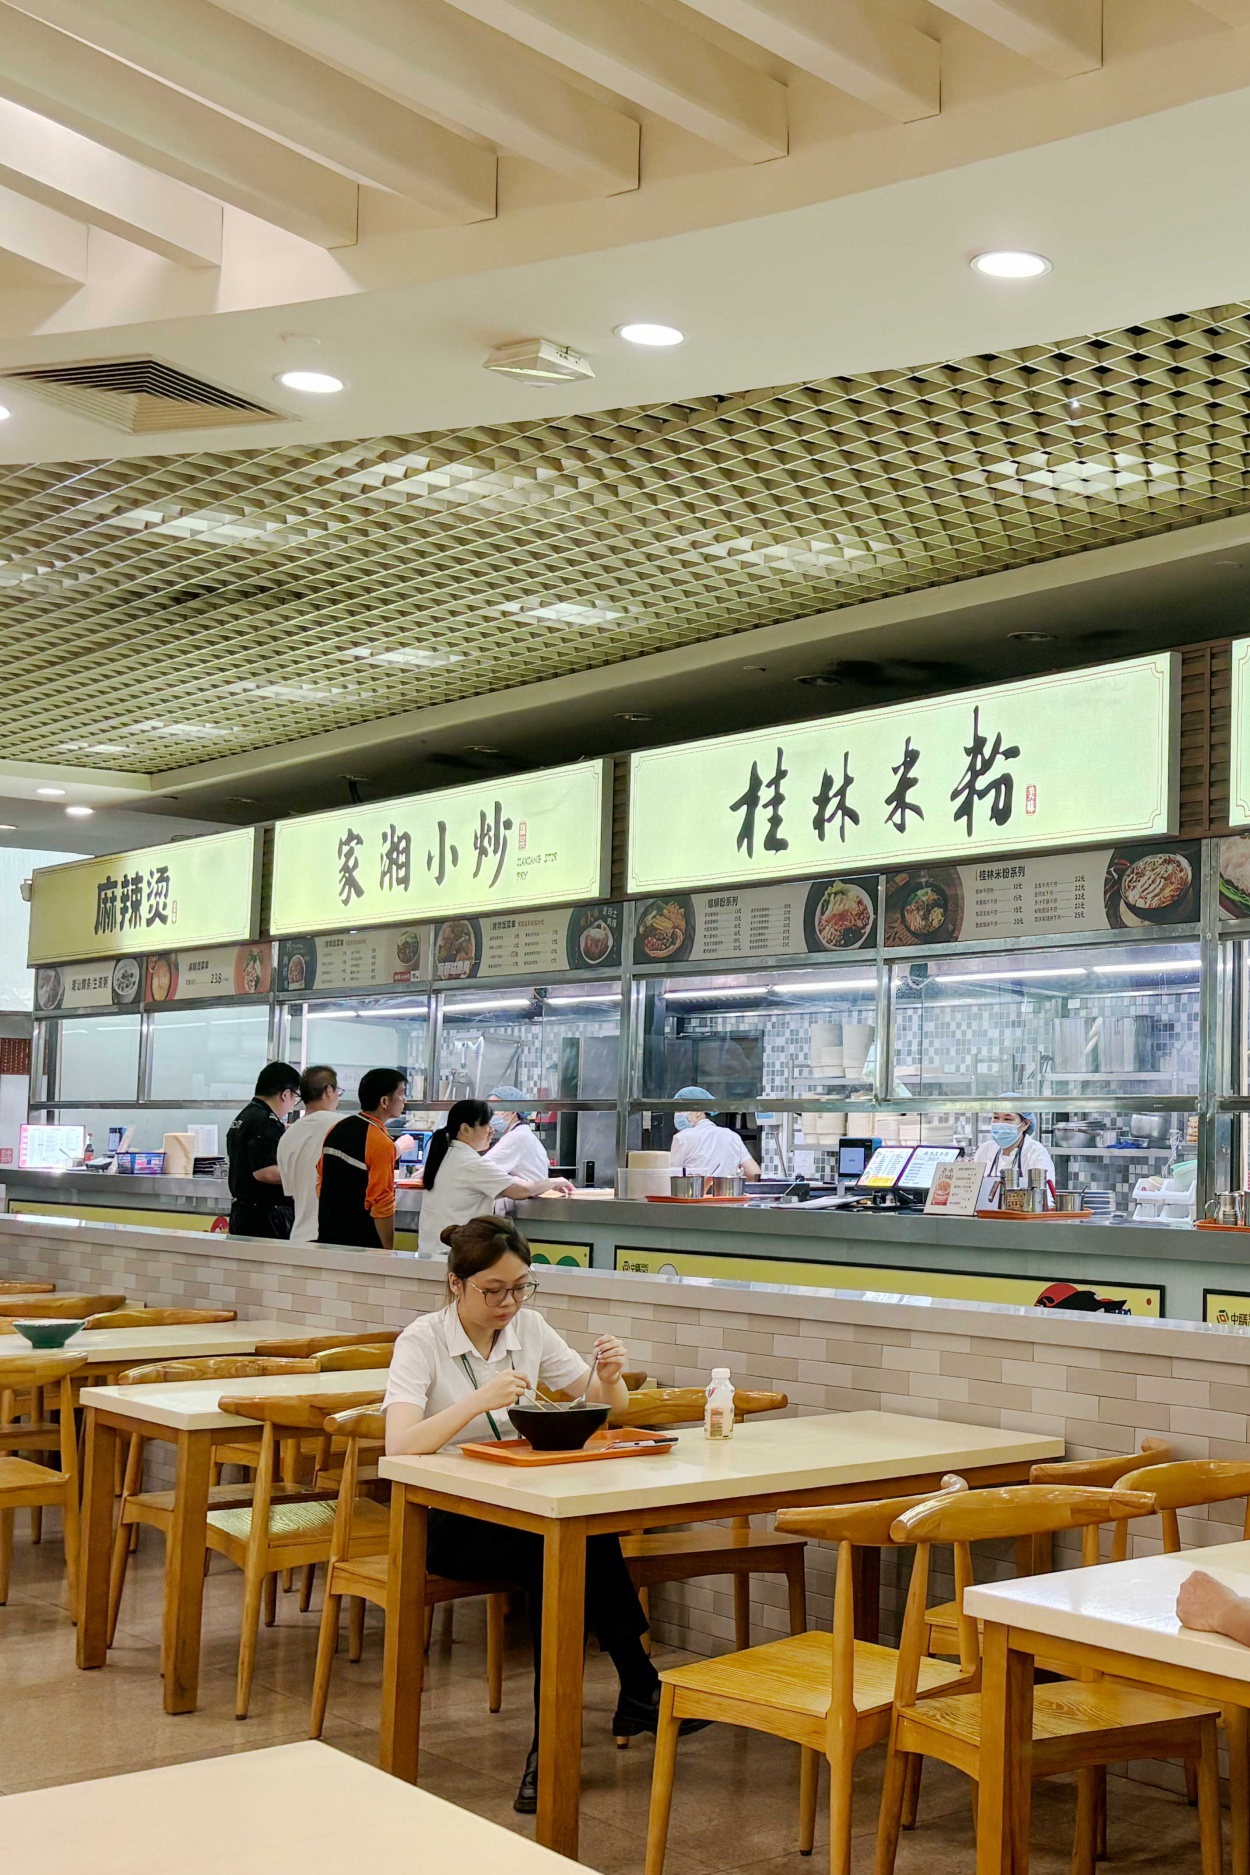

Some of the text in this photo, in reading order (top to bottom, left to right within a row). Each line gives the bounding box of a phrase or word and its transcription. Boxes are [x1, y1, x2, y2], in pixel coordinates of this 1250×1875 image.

[729, 705, 1021, 860] 桂林米粉
[337, 800, 513, 907] 家湘小炒
[979, 865, 1025, 881] 桂林米粉系列
[94, 865, 171, 935] 麻辣烫
